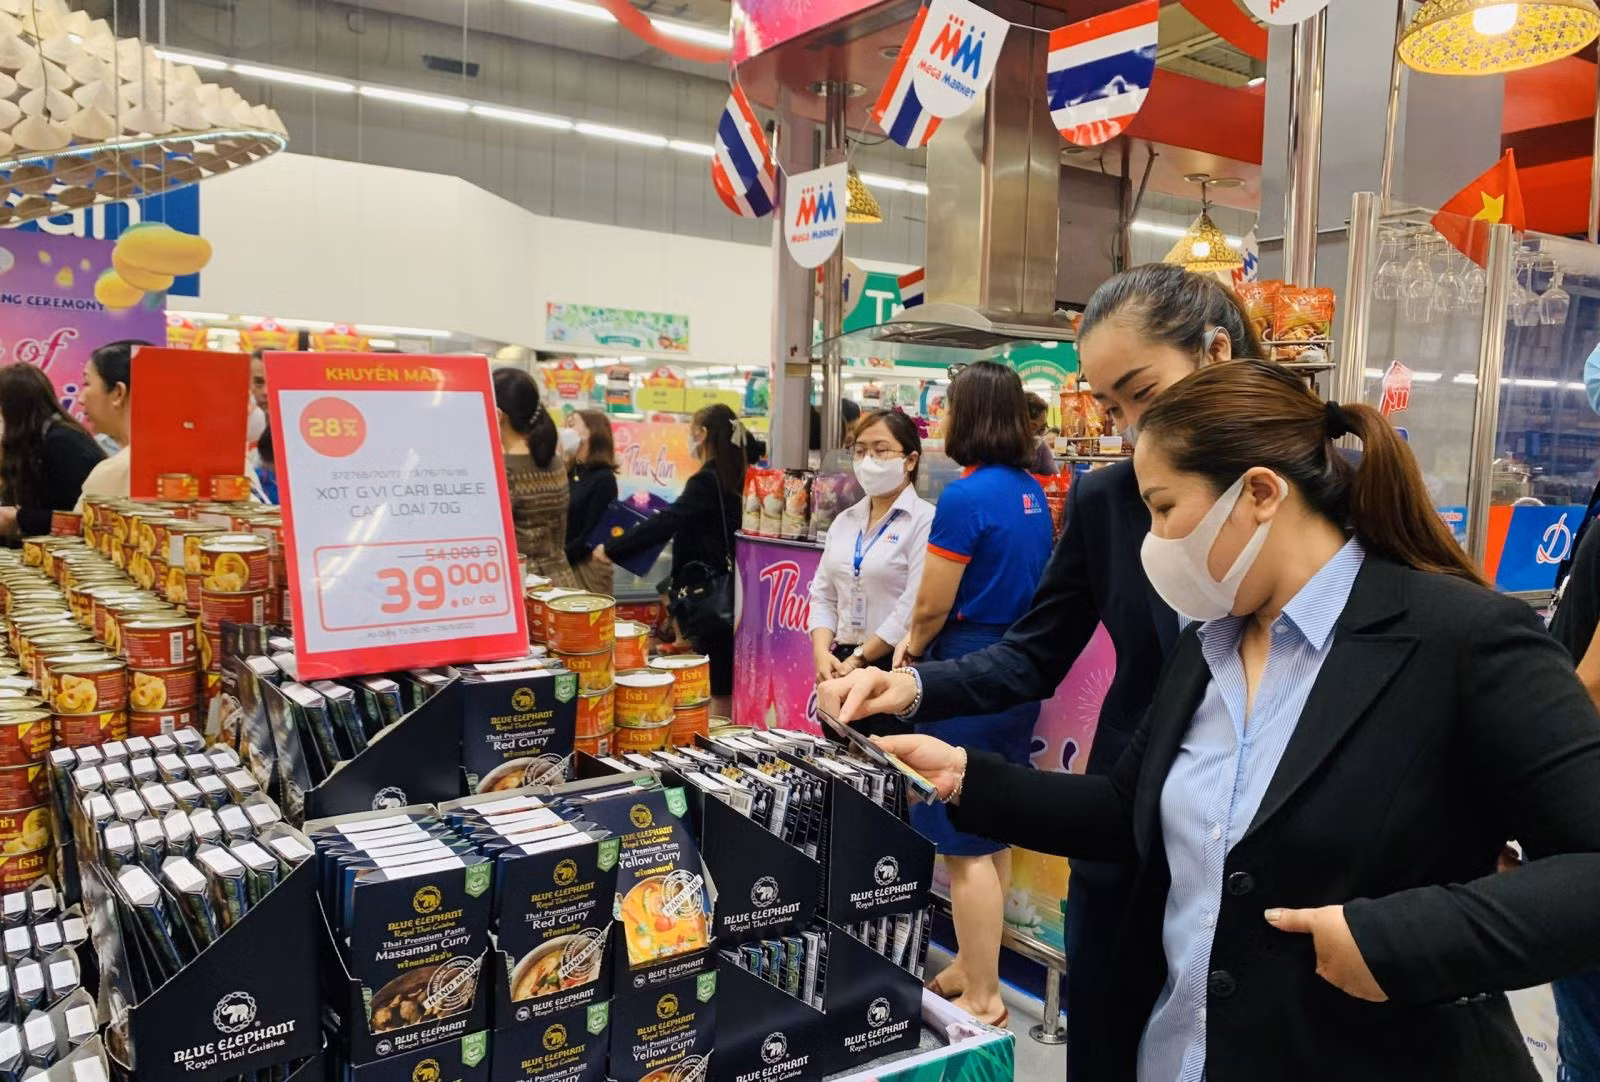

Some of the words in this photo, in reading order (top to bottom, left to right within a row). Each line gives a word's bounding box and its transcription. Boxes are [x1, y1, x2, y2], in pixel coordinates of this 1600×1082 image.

[27, 297, 105, 311] CEREMONY
[430, 501, 461, 514] 70G
[490, 716, 512, 724] BLUE
[513, 711, 554, 722] ELEPHANT
[493, 740, 515, 750] Red
[518, 737, 548, 746] Curry
[504, 730, 536, 739] Premium
[637, 826, 672, 838] ELEPHANT
[601, 840, 617, 849] NEW
[632, 845, 661, 856] Premium
[468, 864, 487, 874] NEW
[619, 856, 653, 869] Yellow
[655, 851, 680, 861] Curry
[531, 892, 553, 902] BLUE
[554, 881, 595, 896] ELEPHANT
[850, 890, 873, 902] BLUE
[874, 881, 918, 898] ELEPHANT
[855, 899, 874, 910] Royal
[876, 896, 889, 907] Thai
[890, 892, 911, 904] Cuisine
[544, 905, 576, 916] Premium
[578, 900, 596, 909] Paste
[723, 912, 750, 925] BLUE
[751, 901, 801, 920] ELEPHANT
[387, 921, 414, 930] BLUE
[415, 909, 463, 925] ELEPHANT
[394, 928, 416, 938] Royal
[416, 925, 431, 933] Thai
[432, 921, 456, 930] Cuisine
[532, 916, 555, 930] Red
[559, 911, 590, 924] Curry
[729, 921, 751, 933] Royal
[752, 918, 768, 929] Thai
[769, 914, 793, 926] Cuisine
[375, 943, 437, 961] Massaman
[441, 934, 471, 948] Curry
[382, 940, 401, 948] Thai
[404, 933, 442, 944] Premium
[445, 927, 465, 935] Paste
[561, 953, 585, 976] HAND
[648, 968, 667, 980] BLUE
[668, 957, 705, 975] ELEPHANT
[427, 983, 455, 1006] HAND
[455, 963, 481, 986] MADE
[700, 973, 714, 982] NEW
[532, 1000, 553, 1012] BLUE
[555, 988, 595, 1005] ELEPHANT
[590, 1004, 606, 1014] NEW
[395, 1032, 418, 1045] BLUE
[421, 1020, 467, 1036] ELEPHANT
[637, 1025, 657, 1035] BLUE
[658, 1013, 696, 1030] ELEPHANT
[844, 1034, 867, 1047] BLUE
[867, 1019, 909, 1041] ELEPHANT
[173, 1042, 215, 1064] BLUE
[217, 1019, 296, 1051] ELEPHANT
[398, 1041, 420, 1050] Royal
[633, 1044, 647, 1052] Thai
[650, 1036, 678, 1047] Premium
[680, 1029, 697, 1037] Paste
[633, 1047, 668, 1061] Yellow
[671, 1037, 696, 1051] Curry
[849, 1041, 868, 1053] Royal
[868, 1037, 882, 1048] Thai
[882, 1033, 903, 1044] Cuisine
[184, 1054, 217, 1071] Royal
[219, 1049, 245, 1062] Thai
[247, 1038, 286, 1054] Cuisine
[521, 1057, 543, 1068] BLUE
[545, 1044, 586, 1061] ELEPHANT
[535, 1070, 568, 1081] Premium
[569, 1062, 588, 1072] Paste
[736, 1069, 761, 1082] BLUE
[762, 1055, 809, 1077] ELEPHANT
